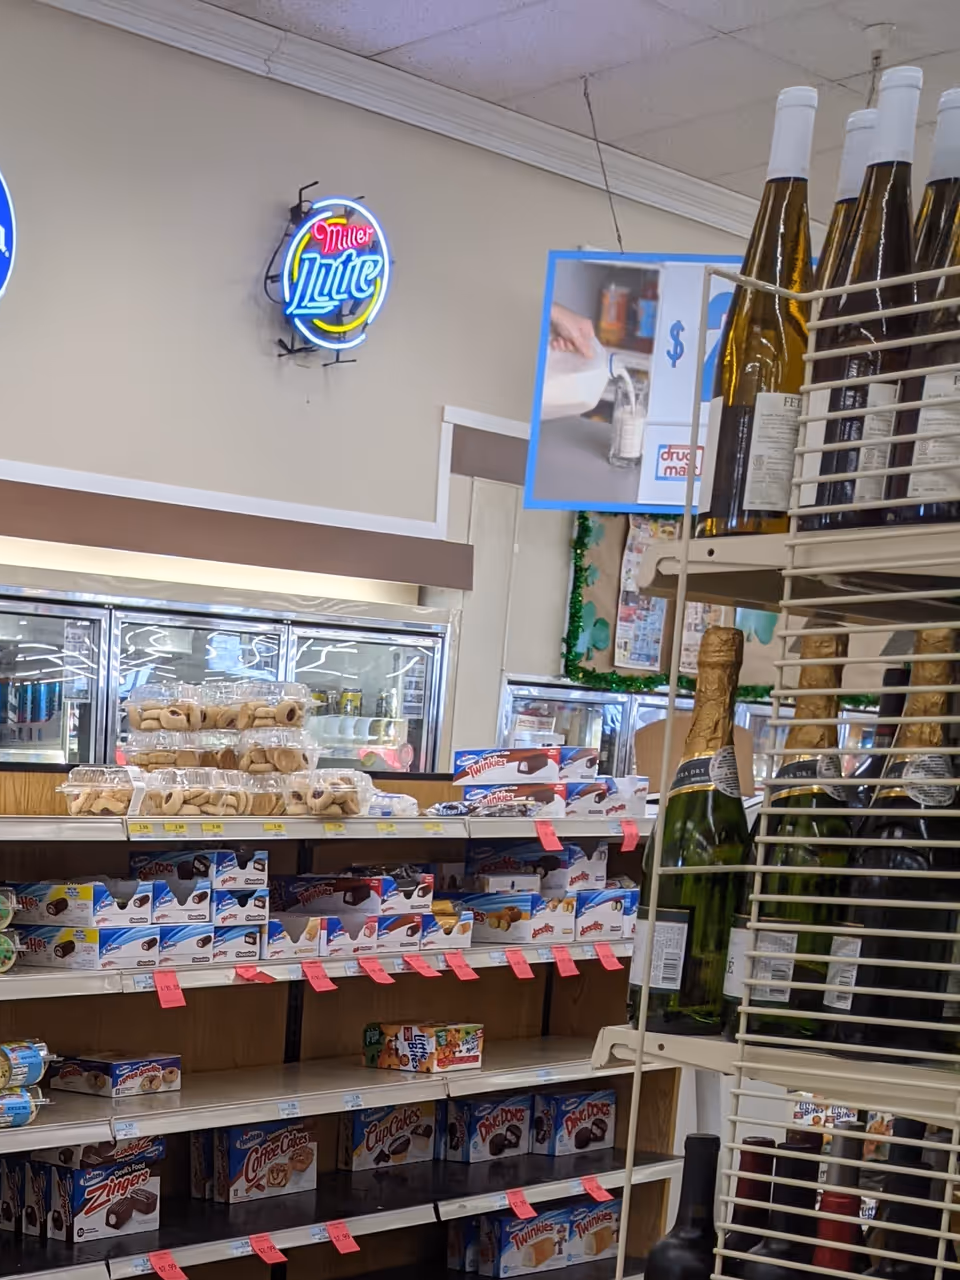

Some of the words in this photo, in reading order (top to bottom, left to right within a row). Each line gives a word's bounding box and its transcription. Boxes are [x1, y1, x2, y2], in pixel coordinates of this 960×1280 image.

[313, 222, 374, 252] Miller
[286, 249, 383, 315] Lite
[666, 320, 685, 368] $
[466, 757, 507, 778] Twinkies
[478, 791, 514, 806] winkies
[407, 1042, 420, 1070] Bites
[414, 1034, 429, 1062] Little
[500, 1105, 525, 1124] DONGS
[587, 1101, 610, 1119] DONGS
[803, 1106, 825, 1116] Bites
[836, 1111, 856, 1121] Bites
[114, 1164, 132, 1178] Devil's
[131, 1161, 146, 1171] Food
[244, 1144, 281, 1184] Coffee
[279, 1130, 310, 1152] Cakes
[84, 1168, 151, 1217] Zingers
[511, 1221, 554, 1251] Twinkies
[574, 1210, 613, 1239] Twinkies
